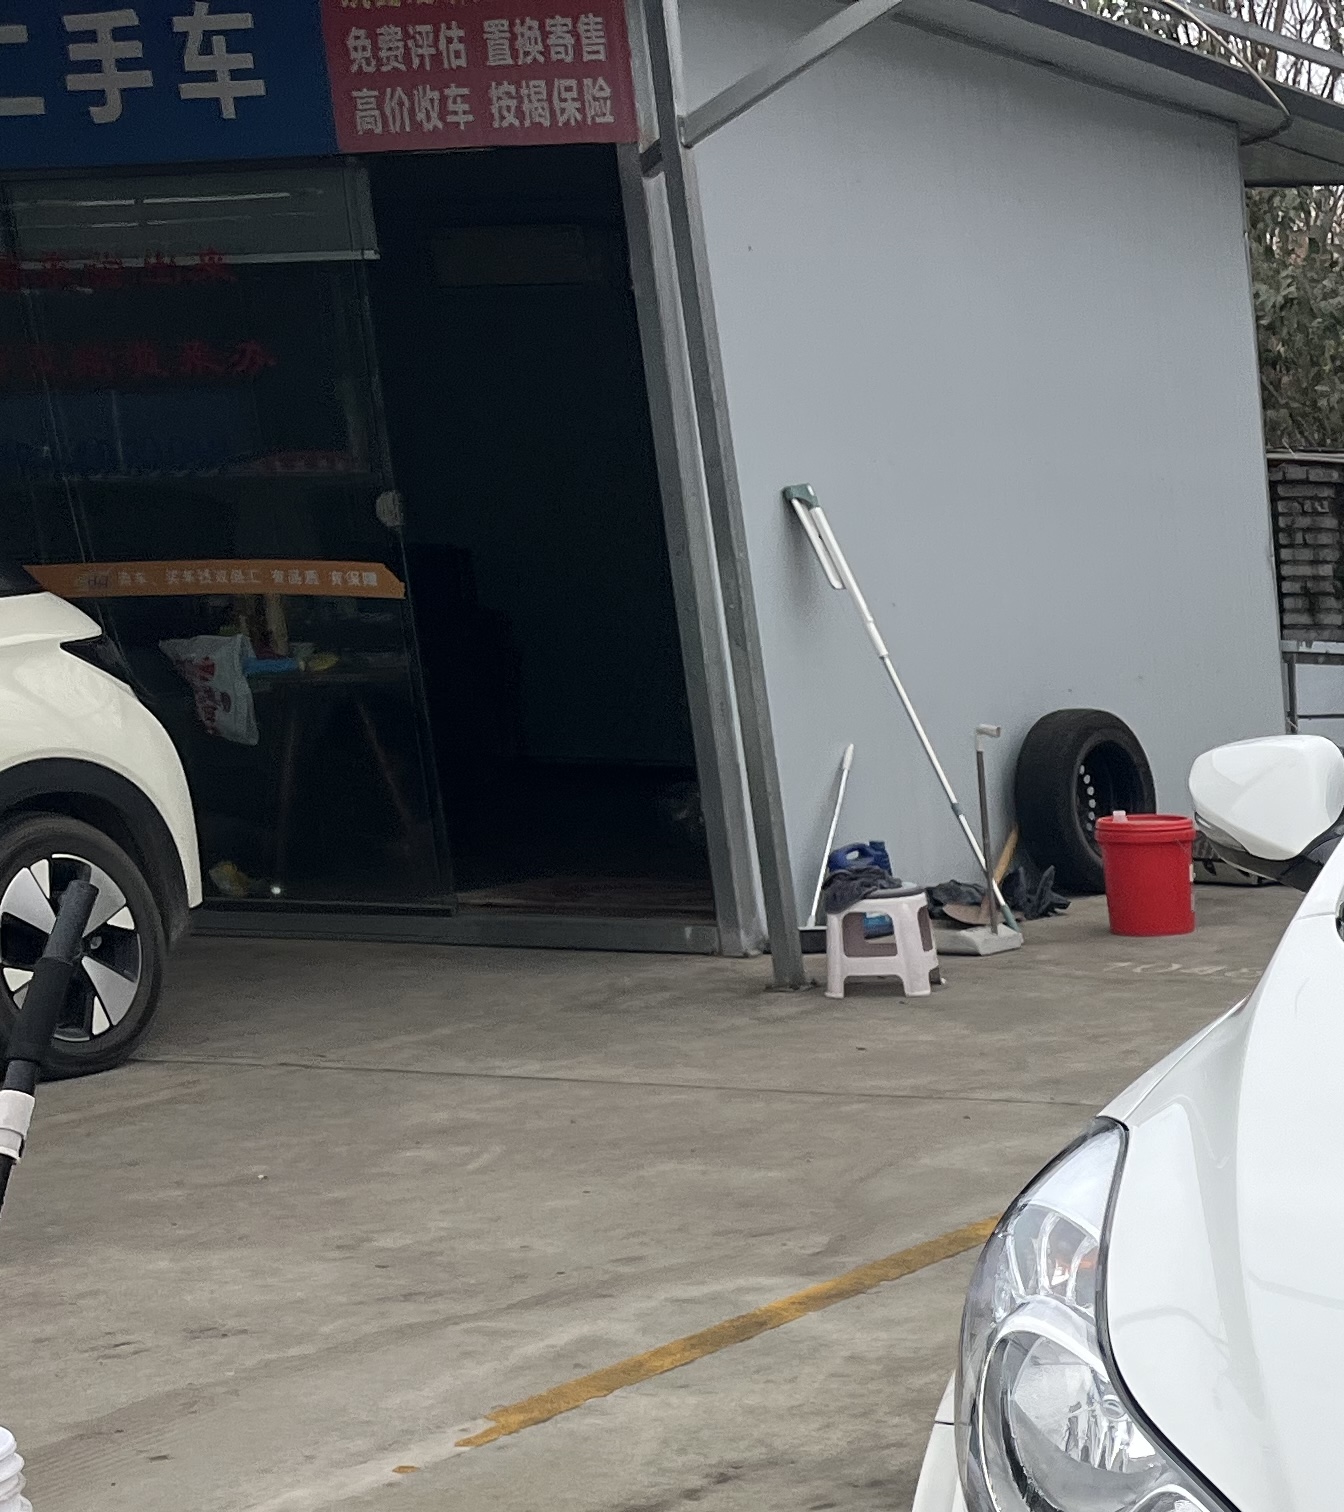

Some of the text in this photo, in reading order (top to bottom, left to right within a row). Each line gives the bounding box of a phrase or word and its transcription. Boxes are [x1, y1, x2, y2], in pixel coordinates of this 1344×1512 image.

[346, 13, 608, 74] 免费评估 置换寄售
[352, 77, 616, 136] 高价收车 按揭保险
